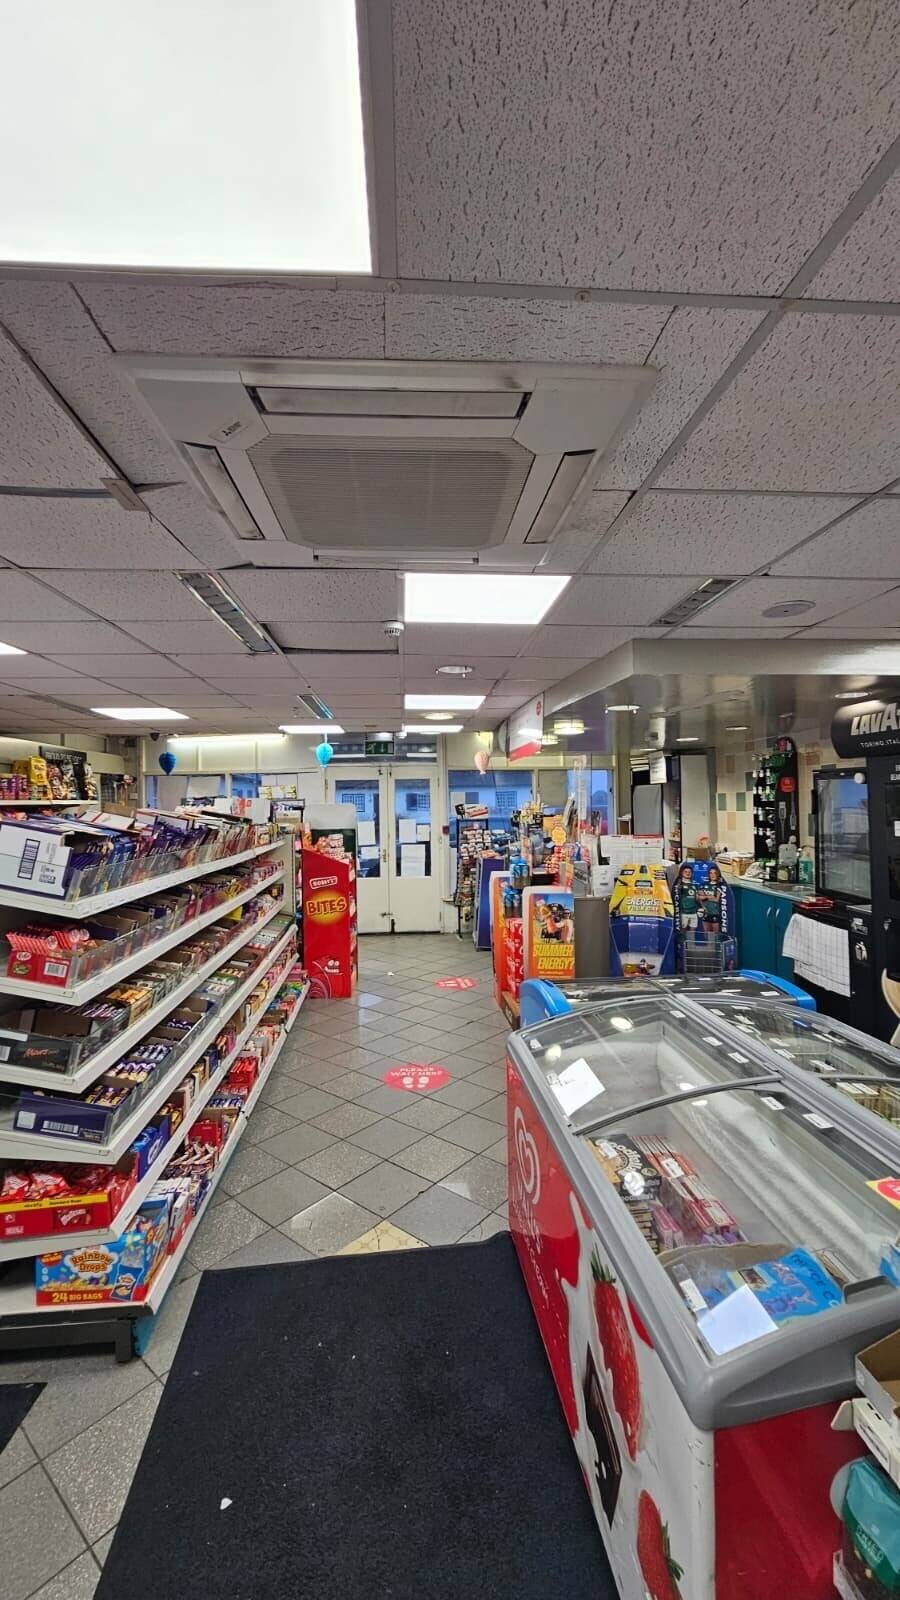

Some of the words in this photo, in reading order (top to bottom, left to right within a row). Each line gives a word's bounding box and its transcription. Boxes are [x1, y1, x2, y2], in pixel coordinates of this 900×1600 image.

[851, 703, 900, 735] LAVA
[306, 896, 347, 916] BITES
[720, 885, 728, 932] PARSONS
[535, 944, 573, 956] SUMMER
[538, 958, 575, 970] ENERGY?
[70, 1250, 113, 1265] Rainbow
[79, 1262, 109, 1273] Drops
[52, 1292, 68, 1303] 24
[83, 1292, 103, 1301] BAGS
